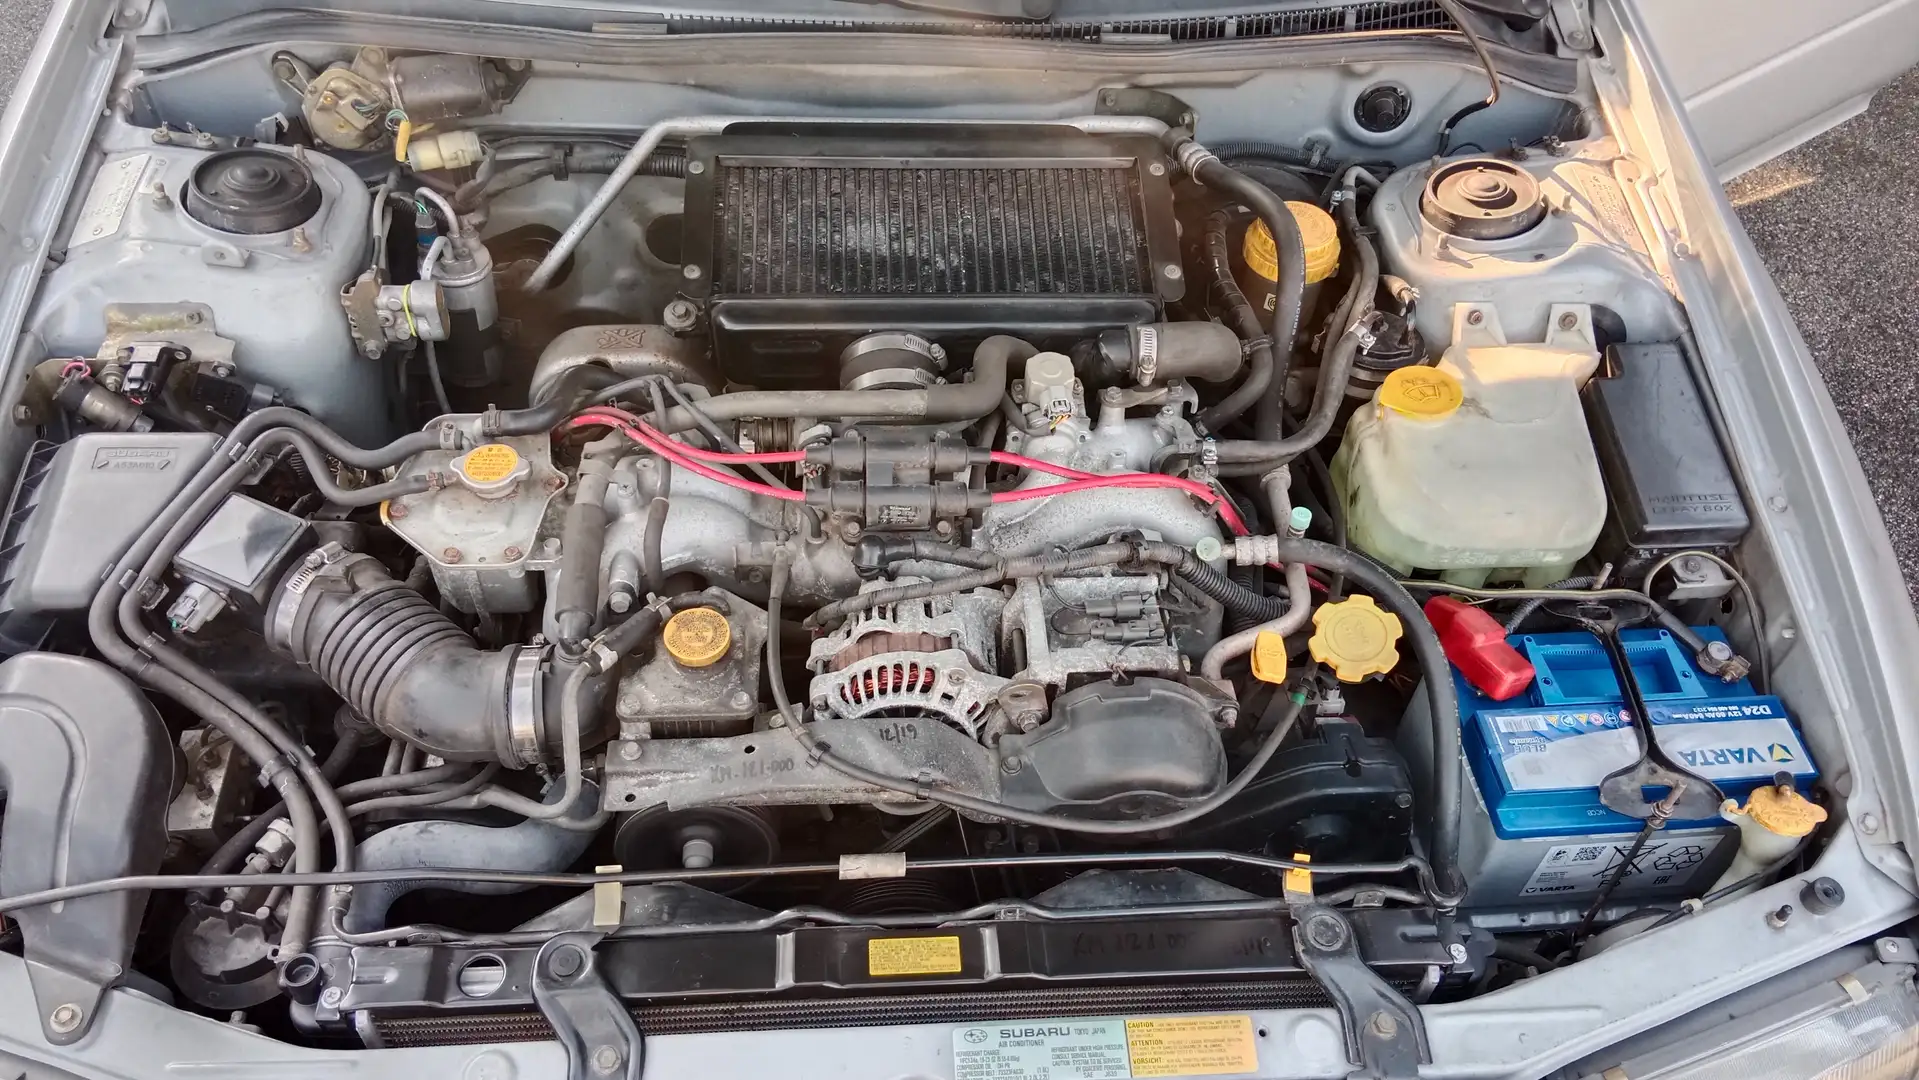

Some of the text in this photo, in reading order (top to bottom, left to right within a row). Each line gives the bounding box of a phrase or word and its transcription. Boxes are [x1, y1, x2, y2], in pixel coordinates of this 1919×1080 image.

[1703, 504, 1733, 513] BOX
[1742, 704, 1772, 716] D24
[879, 722, 917, 743] 12/19
[1514, 744, 1547, 753] BLUE
[1677, 747, 1767, 766] VARTA
[1539, 885, 1575, 893] VARTA
[1000, 1027, 1070, 1038] SUBARU
[1091, 1027, 1106, 1035] JAPAN
[1009, 1039, 1044, 1047] CONDITIONER
